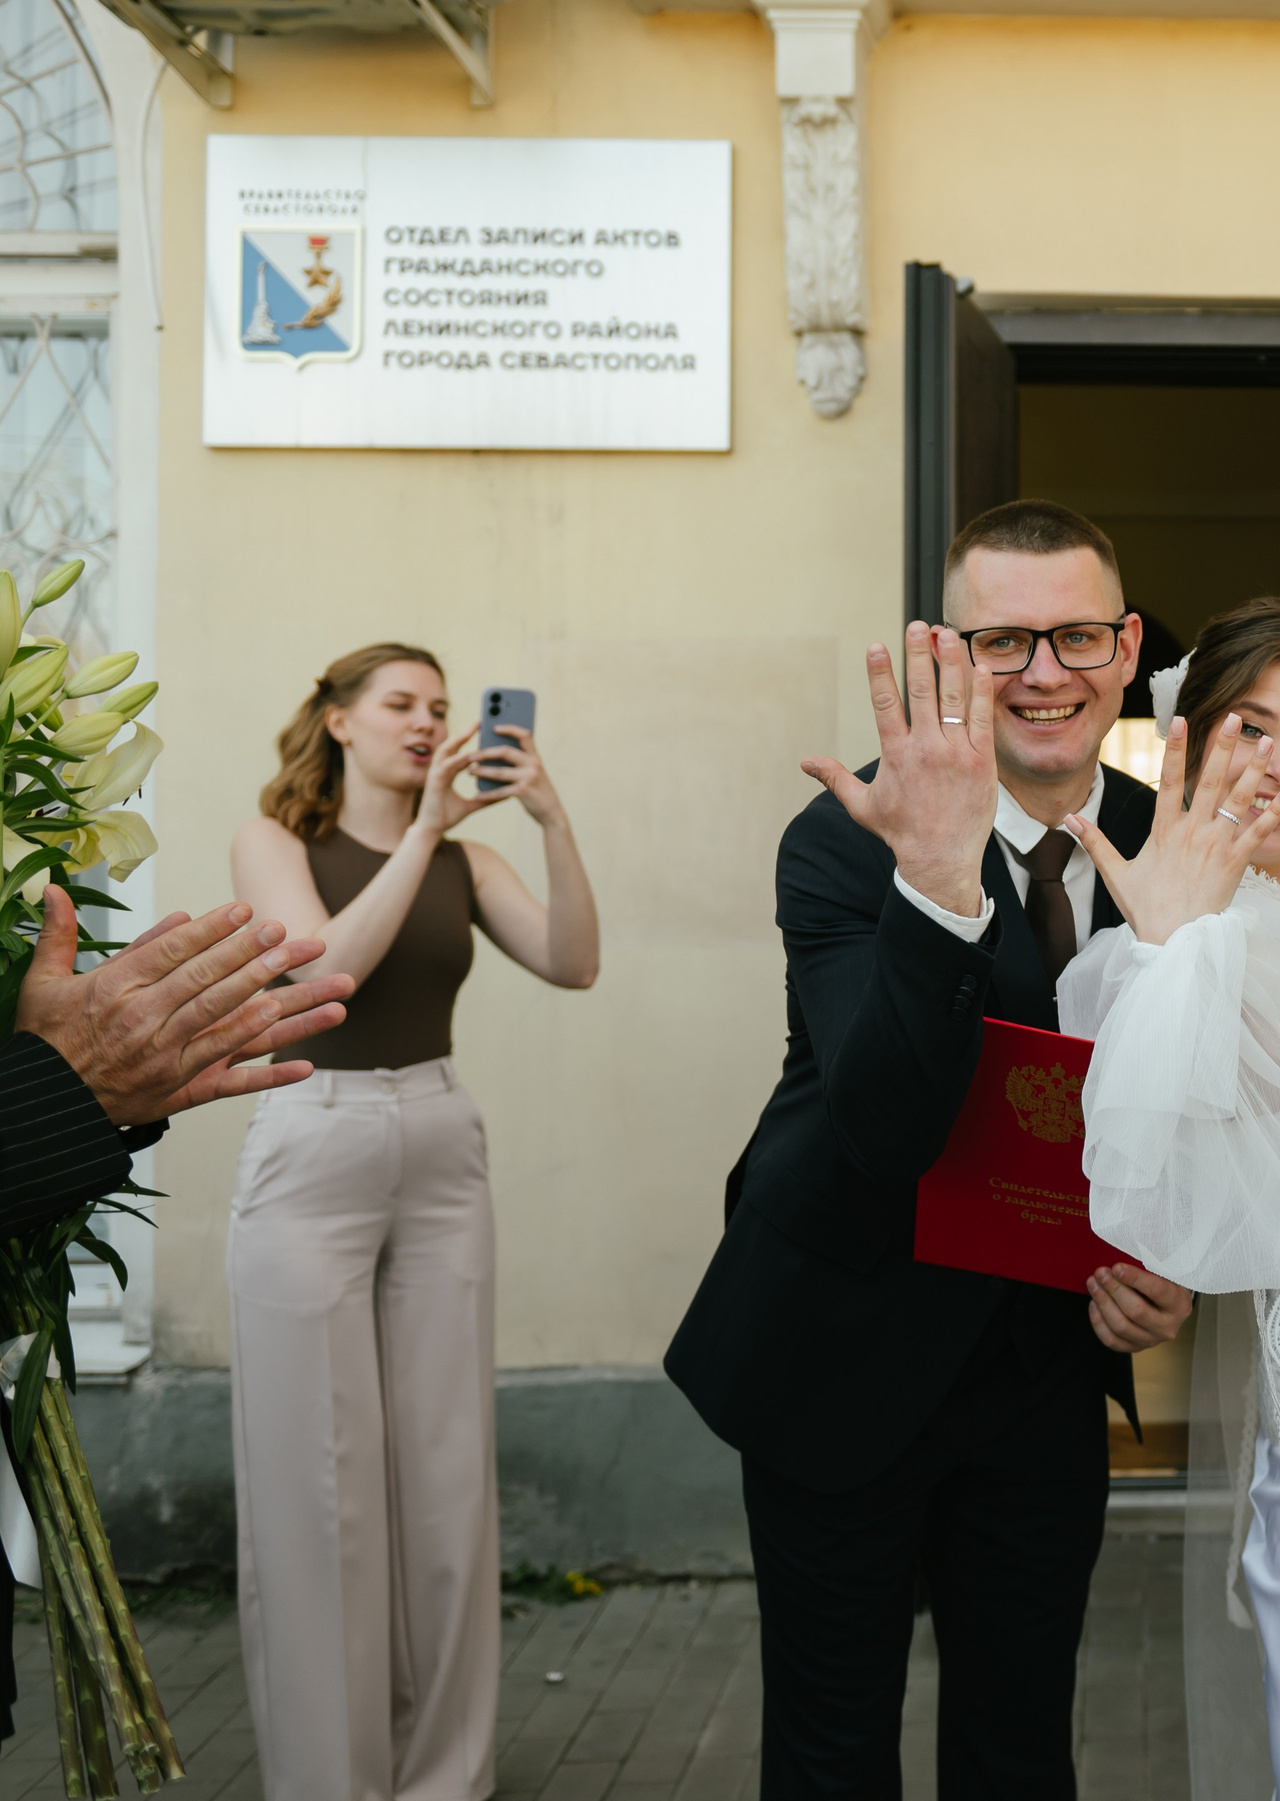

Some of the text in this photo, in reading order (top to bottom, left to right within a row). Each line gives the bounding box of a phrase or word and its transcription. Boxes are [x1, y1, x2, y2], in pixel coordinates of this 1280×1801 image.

[384, 226, 681, 249] ОТДЕЛ ЗАПИСИ АКТОВ
[383, 257, 605, 278] ГРАЖДАНСКОГО
[383, 288, 548, 308] СОСТОЯНИЯ
[383, 316, 679, 341] ЛЕНИНСКОГО РАЙОНА
[383, 350, 696, 372] ГОРОДА СЕВАСТОПОЛЯ
[989, 1177, 1089, 1205] Свидетельств
[992, 1193, 1002, 1202] о
[1020, 1209, 1063, 1226] брака
